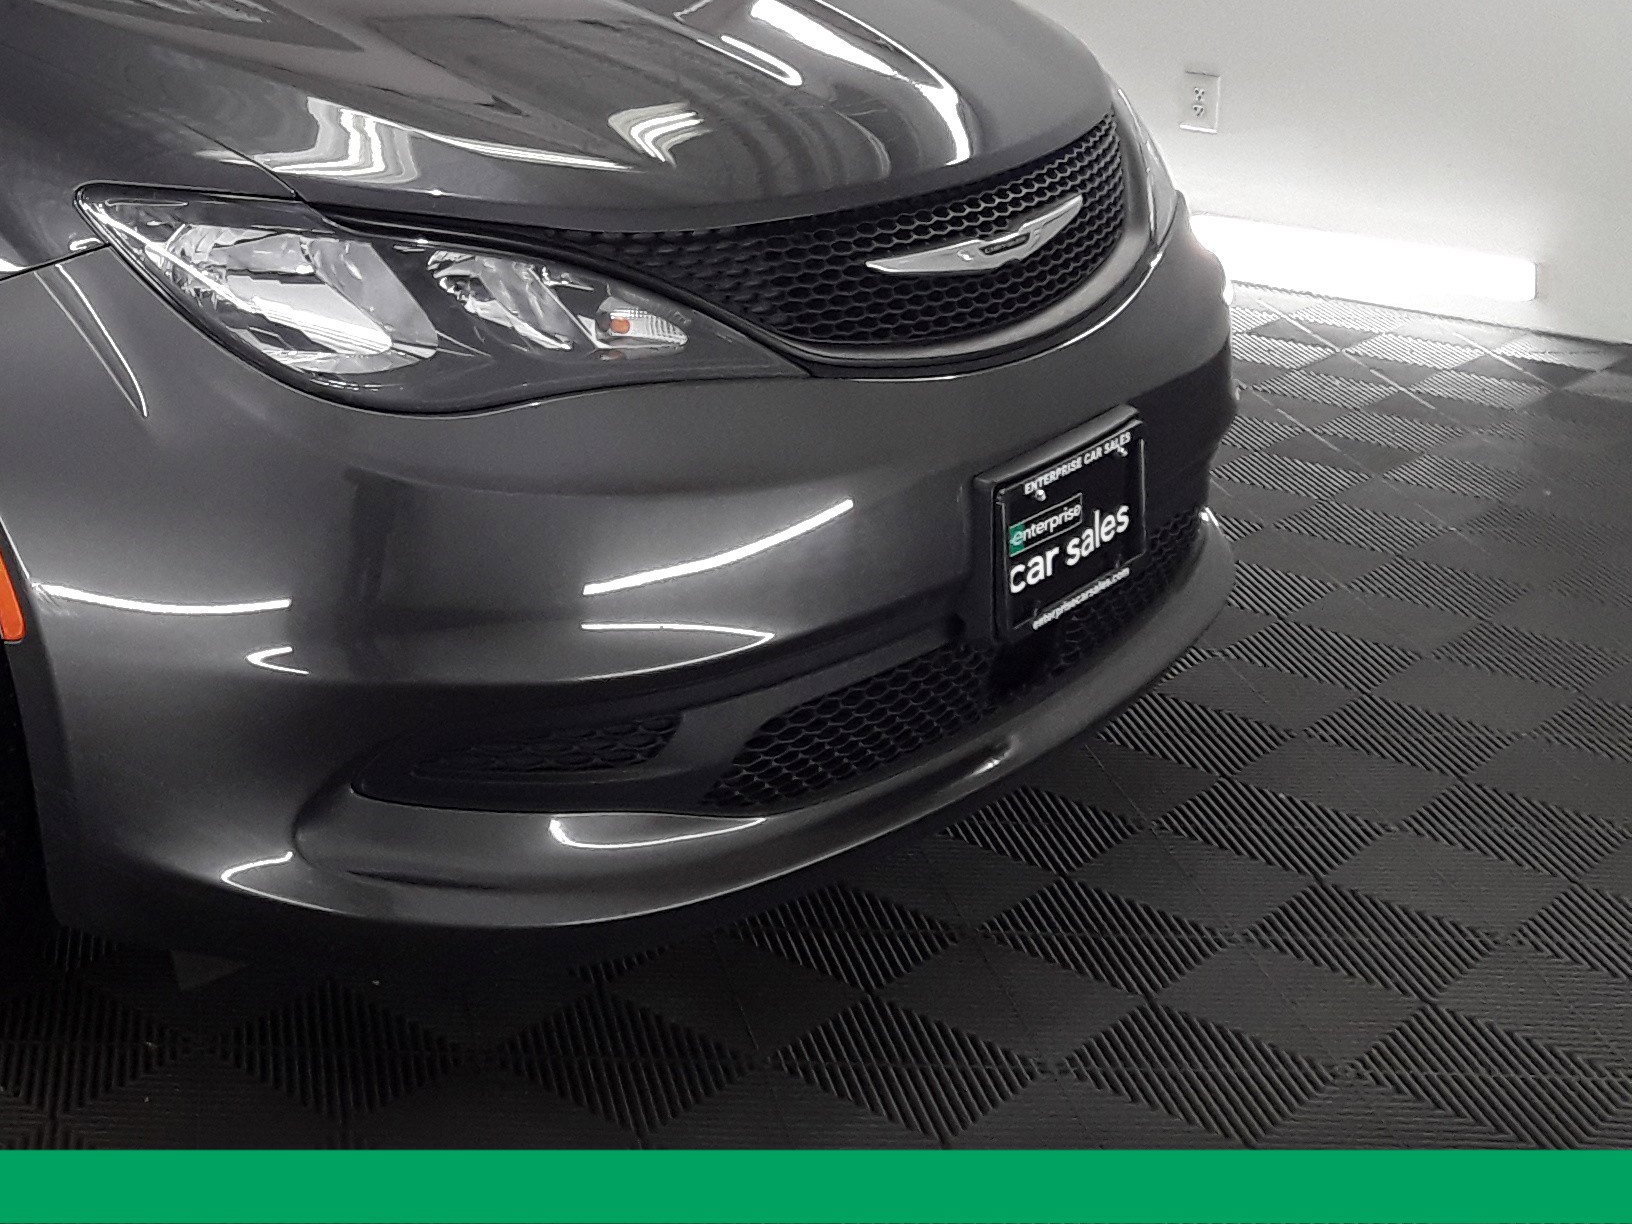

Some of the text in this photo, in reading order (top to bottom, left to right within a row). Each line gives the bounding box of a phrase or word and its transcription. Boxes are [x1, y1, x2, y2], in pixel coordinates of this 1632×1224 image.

[1024, 432, 1131, 495] ENTERPRISE CAR SALES
[1010, 503, 1082, 546] enterprise
[1010, 505, 1130, 593] car sales
